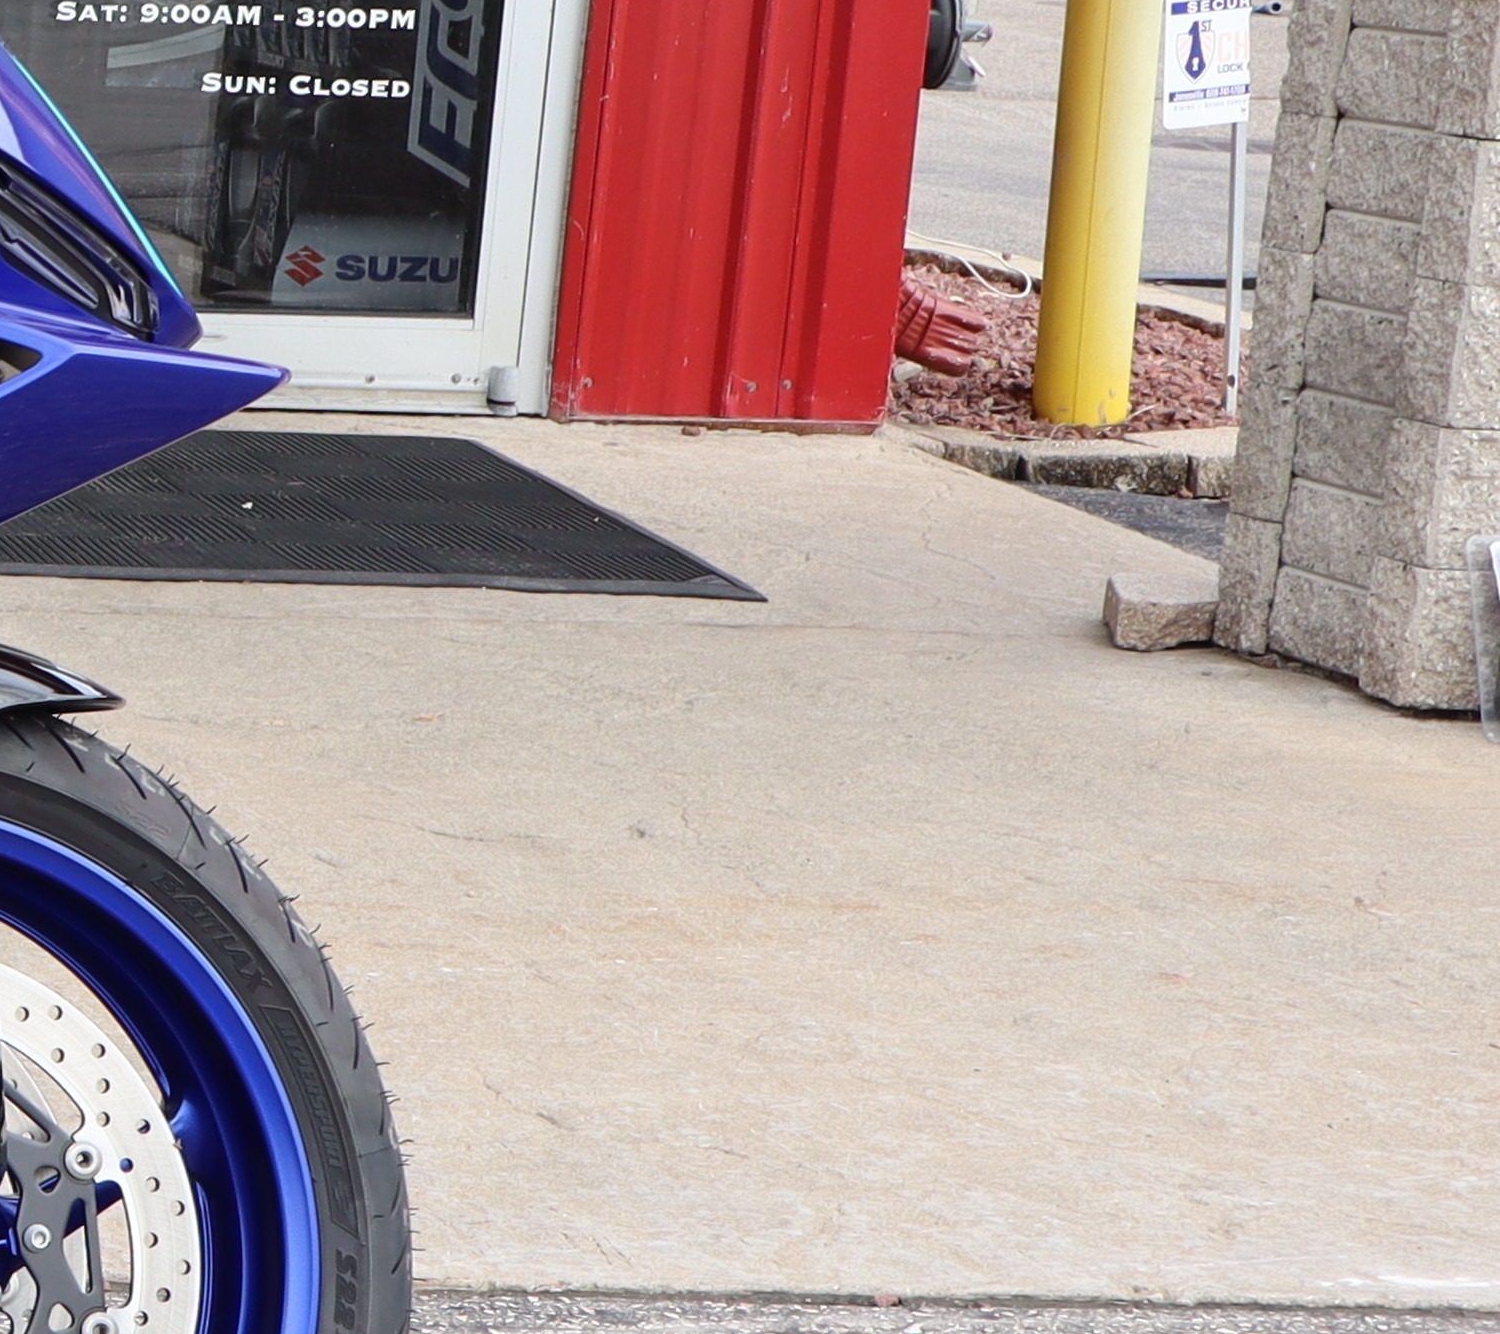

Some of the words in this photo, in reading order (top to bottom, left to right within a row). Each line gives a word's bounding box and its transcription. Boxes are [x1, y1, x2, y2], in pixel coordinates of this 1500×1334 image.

[55, 1, 128, 24] SAT:
[139, 4, 262, 27] 9:00AM
[295, 7, 416, 31] 3:00PM
[1217, 62, 1243, 74] LOCK
[200, 72, 277, 95] SUN:
[288, 74, 411, 99] CLOSED
[335, 254, 459, 285] SUZU
